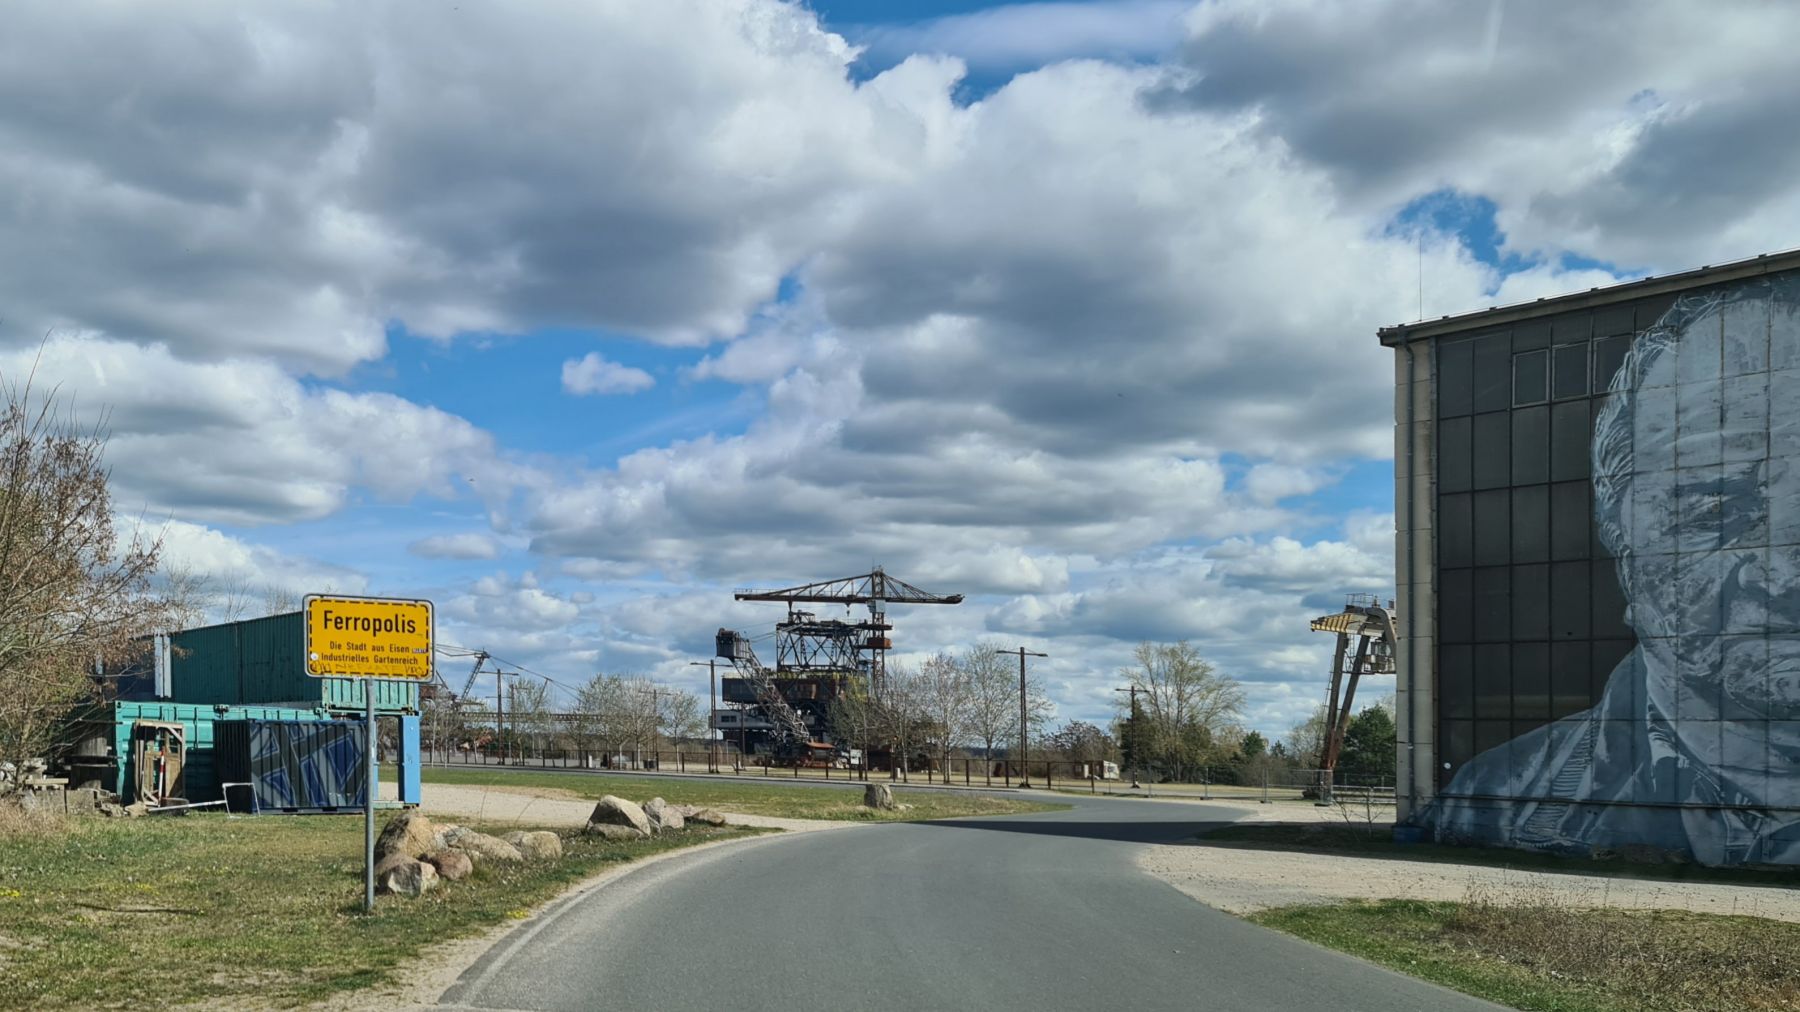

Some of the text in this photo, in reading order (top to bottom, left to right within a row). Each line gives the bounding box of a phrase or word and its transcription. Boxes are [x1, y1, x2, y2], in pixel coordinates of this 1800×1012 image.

[323, 610, 416, 637] Ferropolis
[329, 641, 342, 650] Die
[346, 641, 367, 651] Stadt
[371, 644, 385, 652] aus
[389, 643, 410, 653] Eisen
[321, 652, 419, 665] Industrielles Gartenreich
